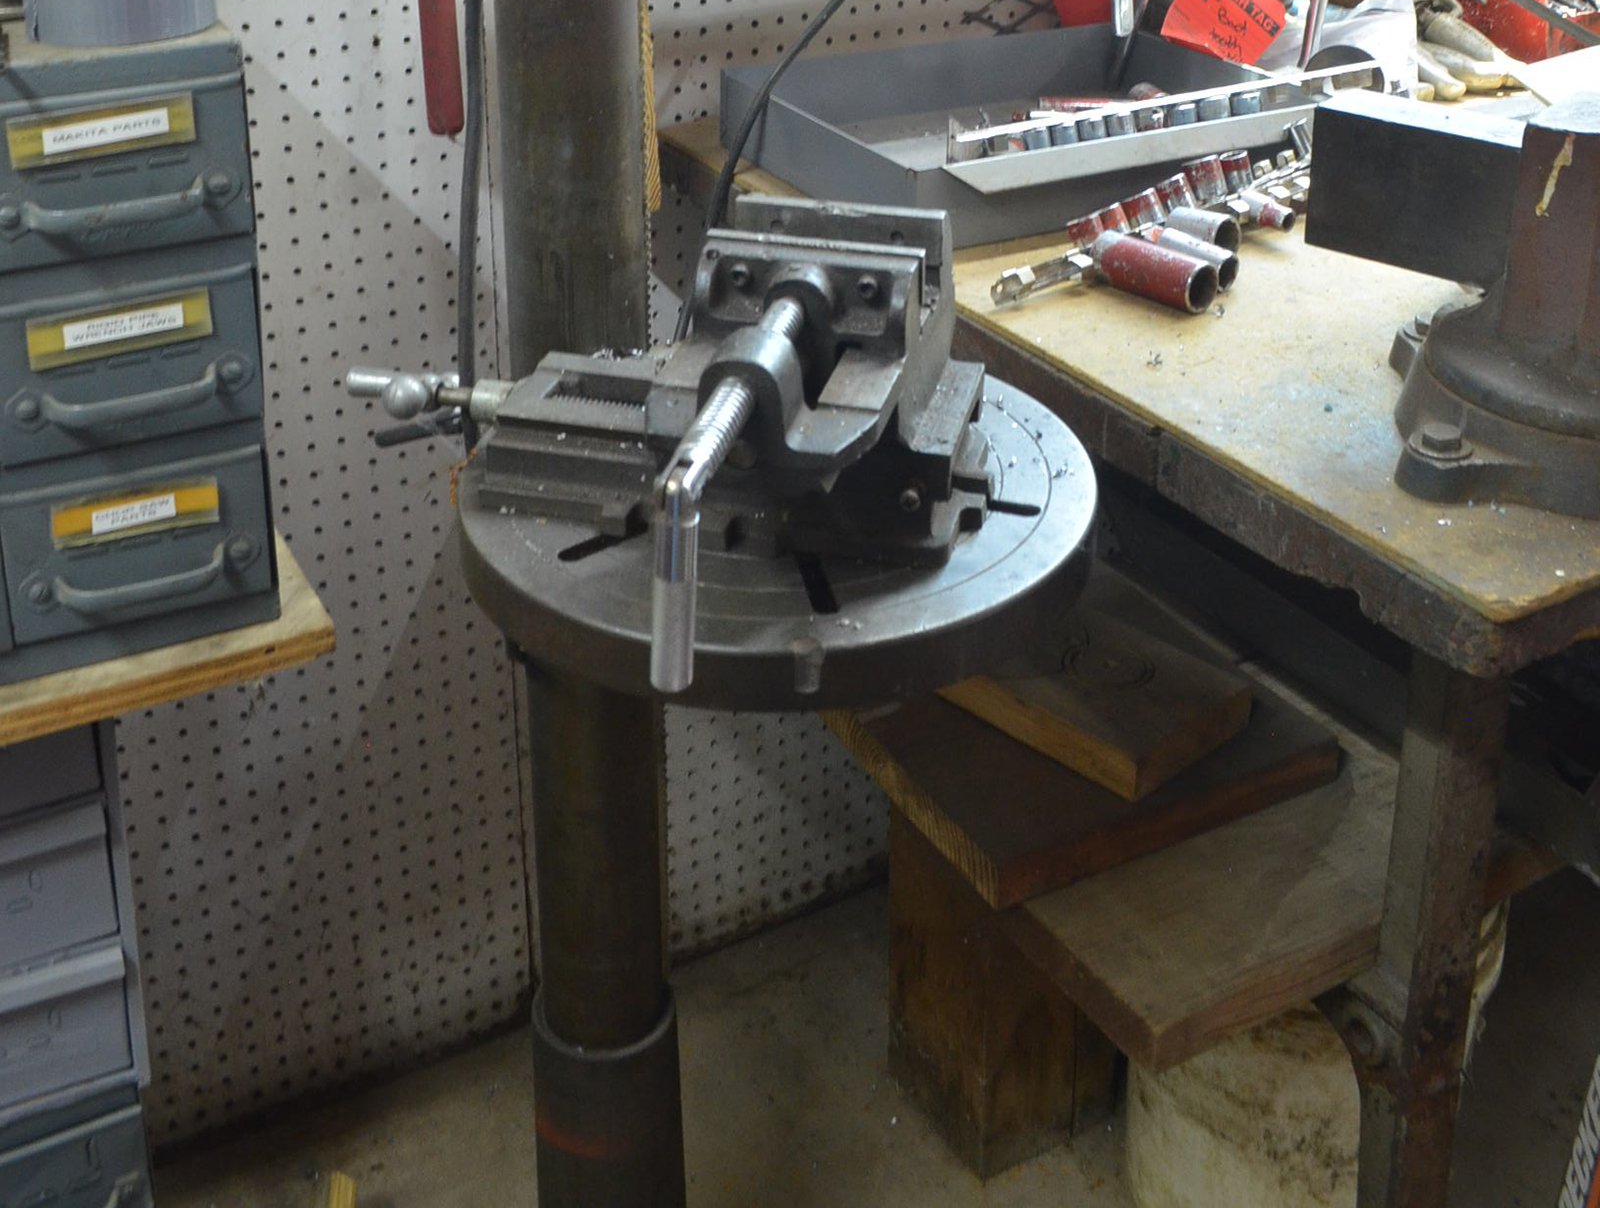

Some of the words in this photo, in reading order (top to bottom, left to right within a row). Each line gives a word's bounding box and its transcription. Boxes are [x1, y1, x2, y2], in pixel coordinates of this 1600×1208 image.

[1250, 6, 1276, 34] TAG
[52, 126, 109, 144] MAKITA
[112, 117, 162, 133] PARTS
[72, 325, 134, 342] WRENCH
